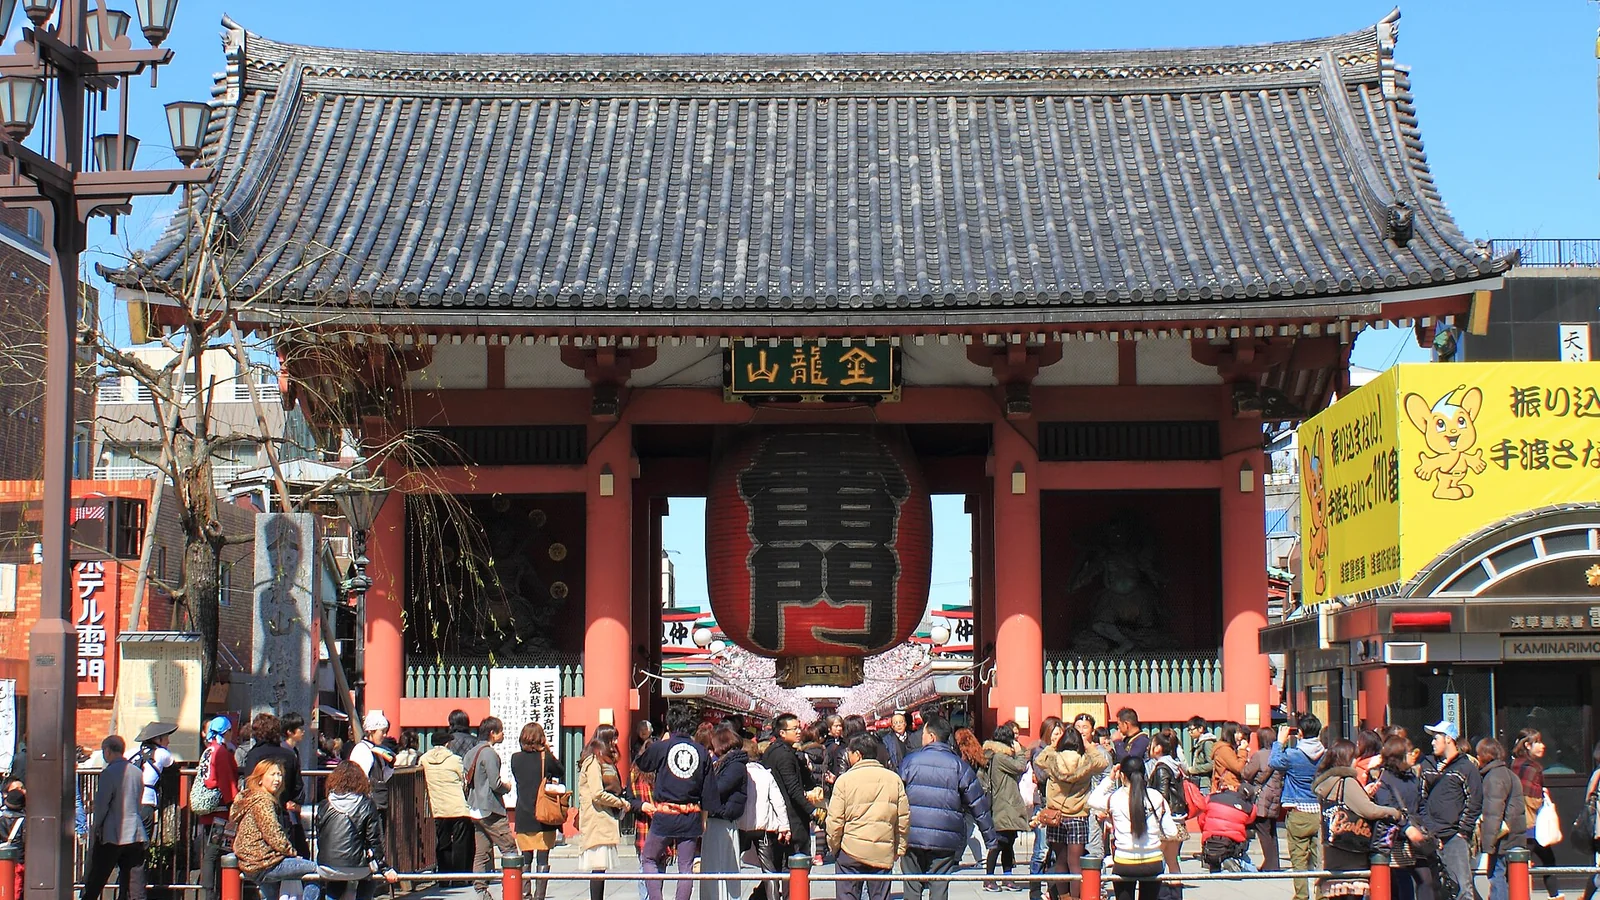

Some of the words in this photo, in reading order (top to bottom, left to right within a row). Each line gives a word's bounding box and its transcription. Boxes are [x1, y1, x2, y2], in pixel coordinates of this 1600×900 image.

[1509, 386, 1600, 418] 振り込
[1489, 438, 1600, 471] 手渡さな
[737, 432, 911, 652] 雷門
